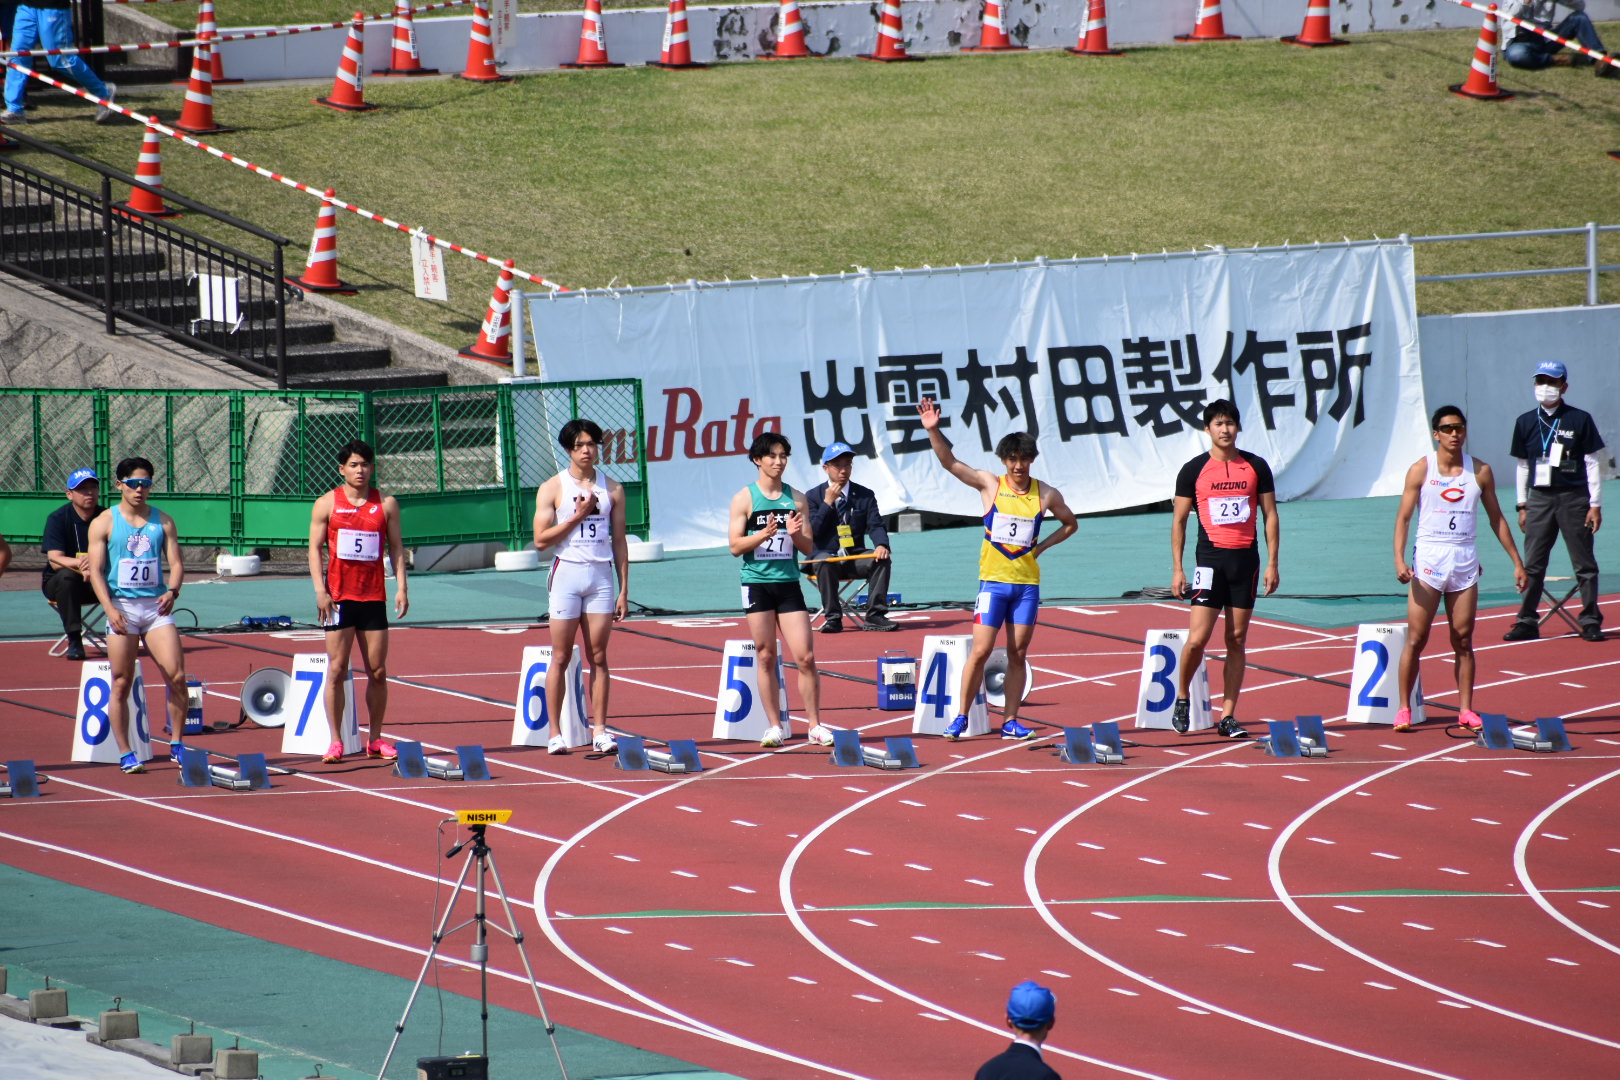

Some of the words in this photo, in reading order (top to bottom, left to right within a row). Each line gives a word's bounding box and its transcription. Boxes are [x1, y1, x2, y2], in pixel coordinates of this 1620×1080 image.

[800, 322, 1372, 466] 出雲村田製作所
[1211, 480, 1248, 491] MIZUNO
[1220, 502, 1240, 517] 23
[580, 523, 596, 538] 19
[1009, 522, 1018, 537] 3
[1449, 516, 1456, 530] 6
[354, 538, 363, 554] 5
[766, 537, 785, 553] 27
[130, 566, 150, 581] 20
[1195, 570, 1201, 586] 3
[1146, 645, 1177, 713] 3
[1357, 640, 1389, 708] 2
[723, 655, 754, 723] 5
[921, 652, 952, 718] 4
[294, 671, 323, 736] 7
[523, 662, 549, 731] 6
[82, 677, 111, 745] 8
[467, 813, 497, 822] NISHI
